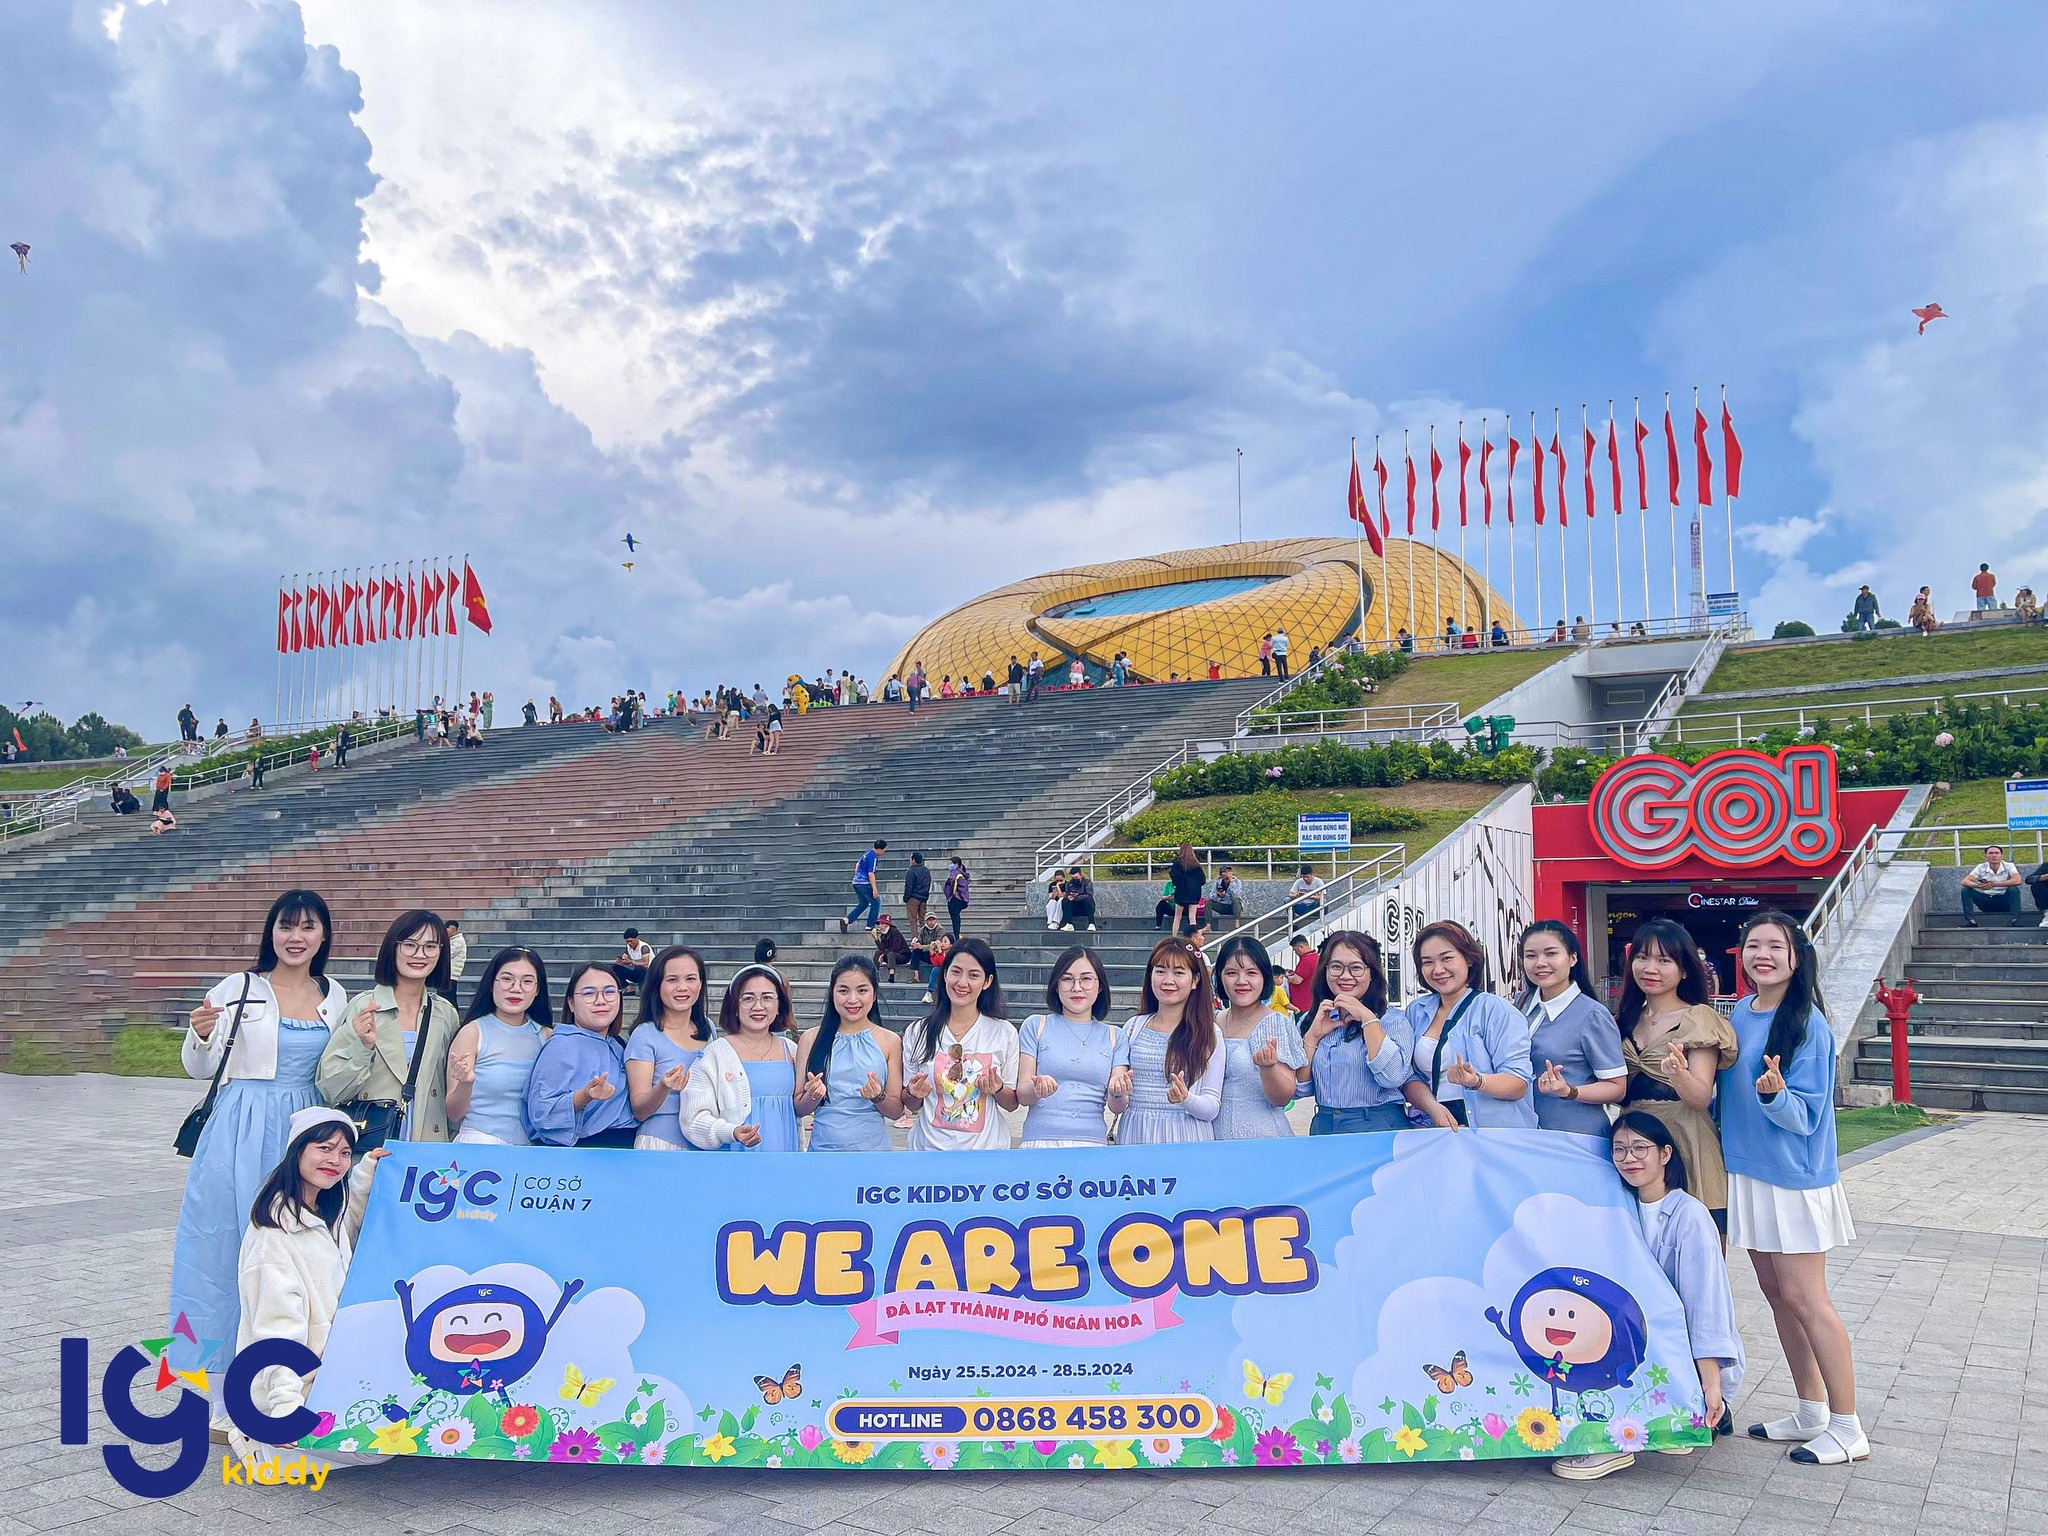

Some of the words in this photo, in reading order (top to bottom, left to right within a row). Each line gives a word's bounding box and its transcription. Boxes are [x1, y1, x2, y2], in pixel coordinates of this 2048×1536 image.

[1588, 744, 1844, 870] GO!
[2010, 818, 2048, 827] vinapho
[1687, 893, 1736, 909] CINESTAR
[523, 1176, 552, 1191] CƠ
[556, 1174, 583, 1192] SỞ
[856, 1185, 901, 1205] IGC
[906, 1183, 987, 1204] KIDDY
[991, 1179, 1031, 1202] CƠ
[1035, 1173, 1074, 1200] SỞ
[1078, 1173, 1157, 1201] QUẬN
[1161, 1177, 1178, 1196] 7
[519, 1194, 577, 1214] QUẬN
[580, 1198, 593, 1212] 7
[716, 1219, 877, 1305] WE
[885, 1214, 1090, 1302] ARE
[1098, 1206, 1320, 1299] ONE
[885, 1300, 911, 1320] ĐÀ
[915, 1301, 947, 1318] LẠT
[950, 1299, 1010, 1322] THÀNH
[1013, 1308, 1049, 1328] PHỐ
[1052, 1313, 1101, 1332] NGÀN
[1105, 1312, 1143, 1331] HOA
[907, 1365, 952, 1382] Ngày
[955, 1364, 1038, 1380] 25.5.2024
[1052, 1362, 1134, 1378] 28.5.2024
[858, 1412, 943, 1429] HOTLINE
[973, 1406, 1058, 1433] 0868
[1065, 1404, 1128, 1431] 458
[1135, 1402, 1202, 1429] 300
